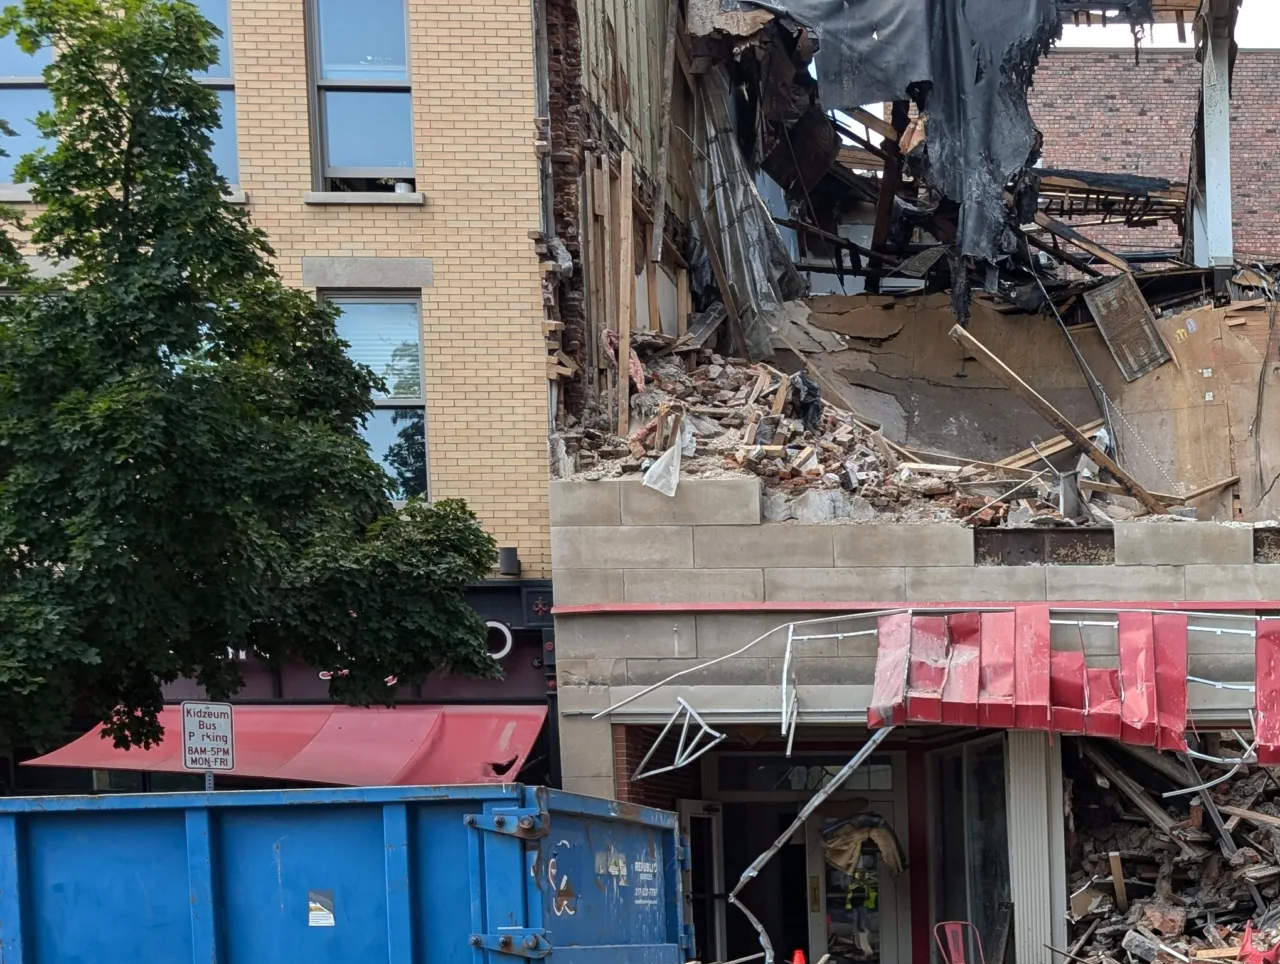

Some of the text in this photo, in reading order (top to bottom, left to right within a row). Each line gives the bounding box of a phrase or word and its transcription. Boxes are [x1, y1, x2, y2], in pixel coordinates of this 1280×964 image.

[186, 708, 229, 719] Kidzeum
[198, 720, 216, 730] Bus
[188, 731, 228, 745] Prking
[187, 746, 229, 756] 8AM-5PM
[190, 757, 228, 767] MON-FRI
